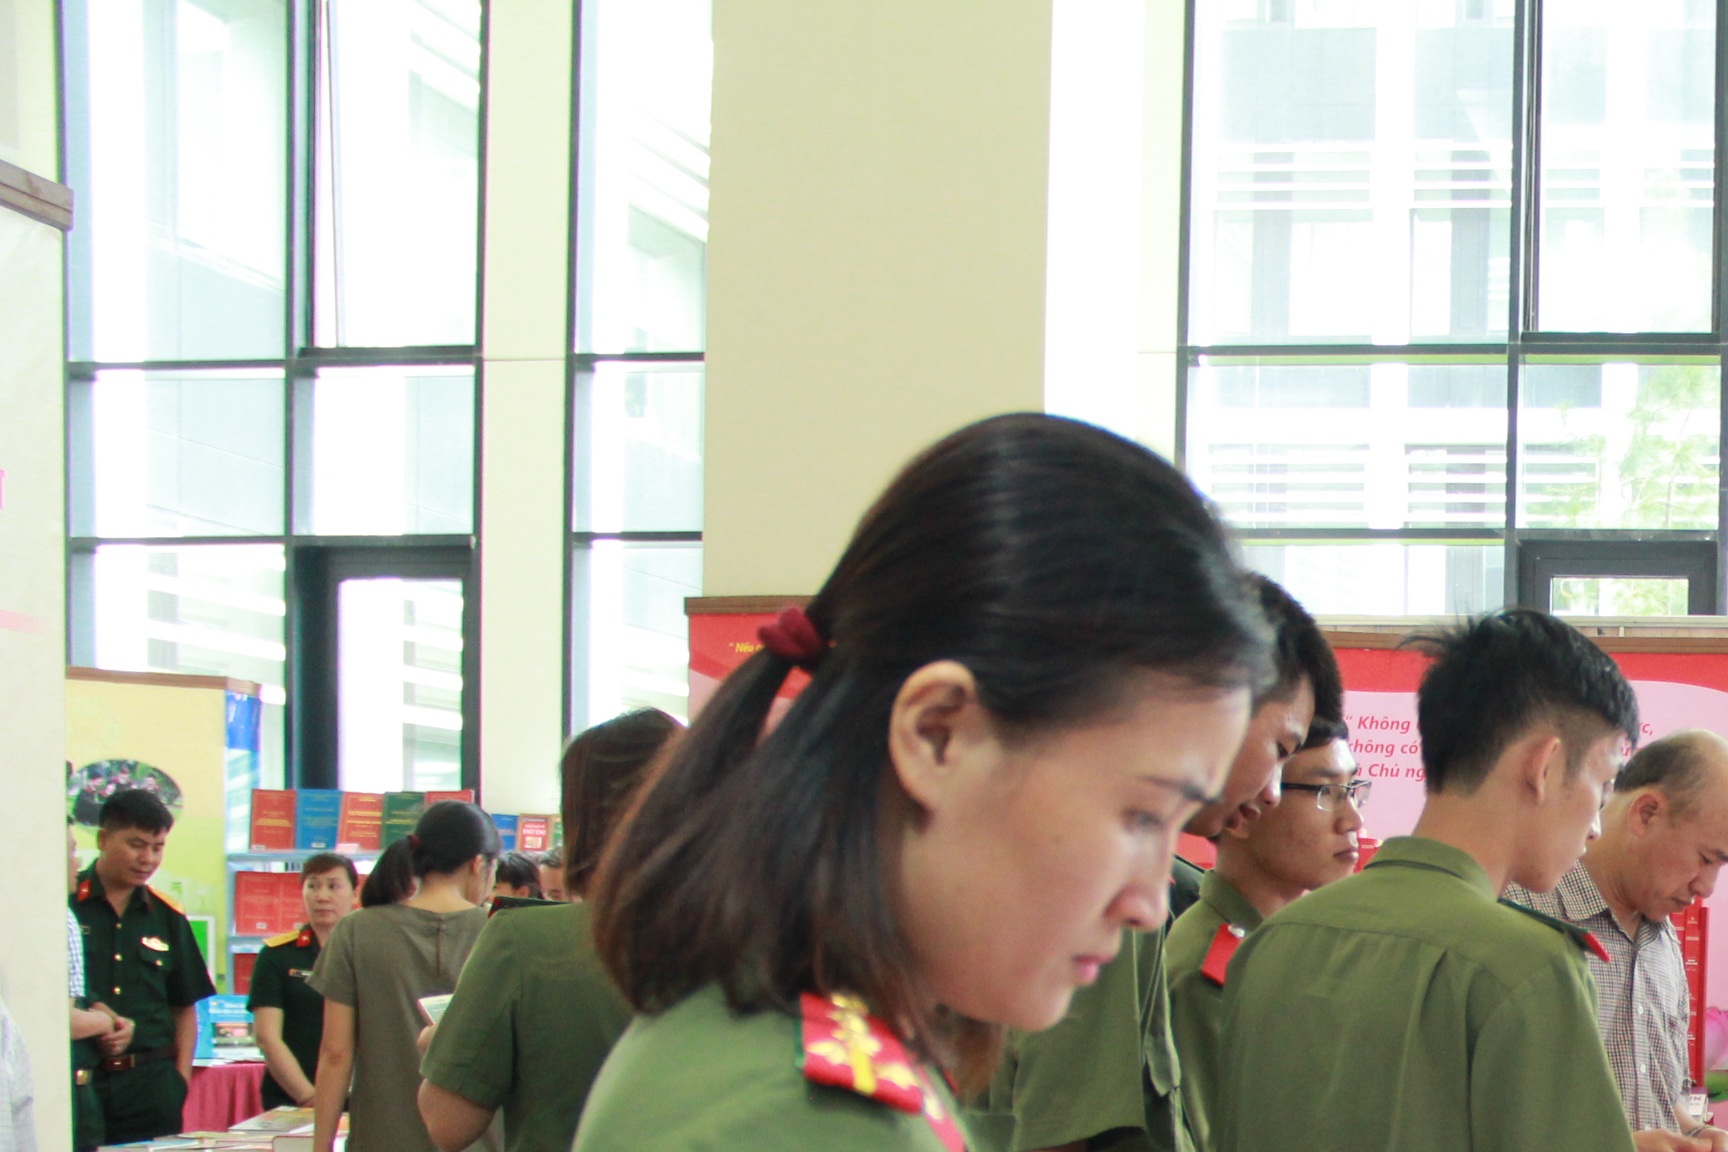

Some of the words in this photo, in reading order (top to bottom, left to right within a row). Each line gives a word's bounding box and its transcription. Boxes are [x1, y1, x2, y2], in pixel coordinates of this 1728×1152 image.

[1357, 716, 1411, 734] Không
[1400, 740, 1419, 754] có
[1368, 763, 1400, 778] Chủ
